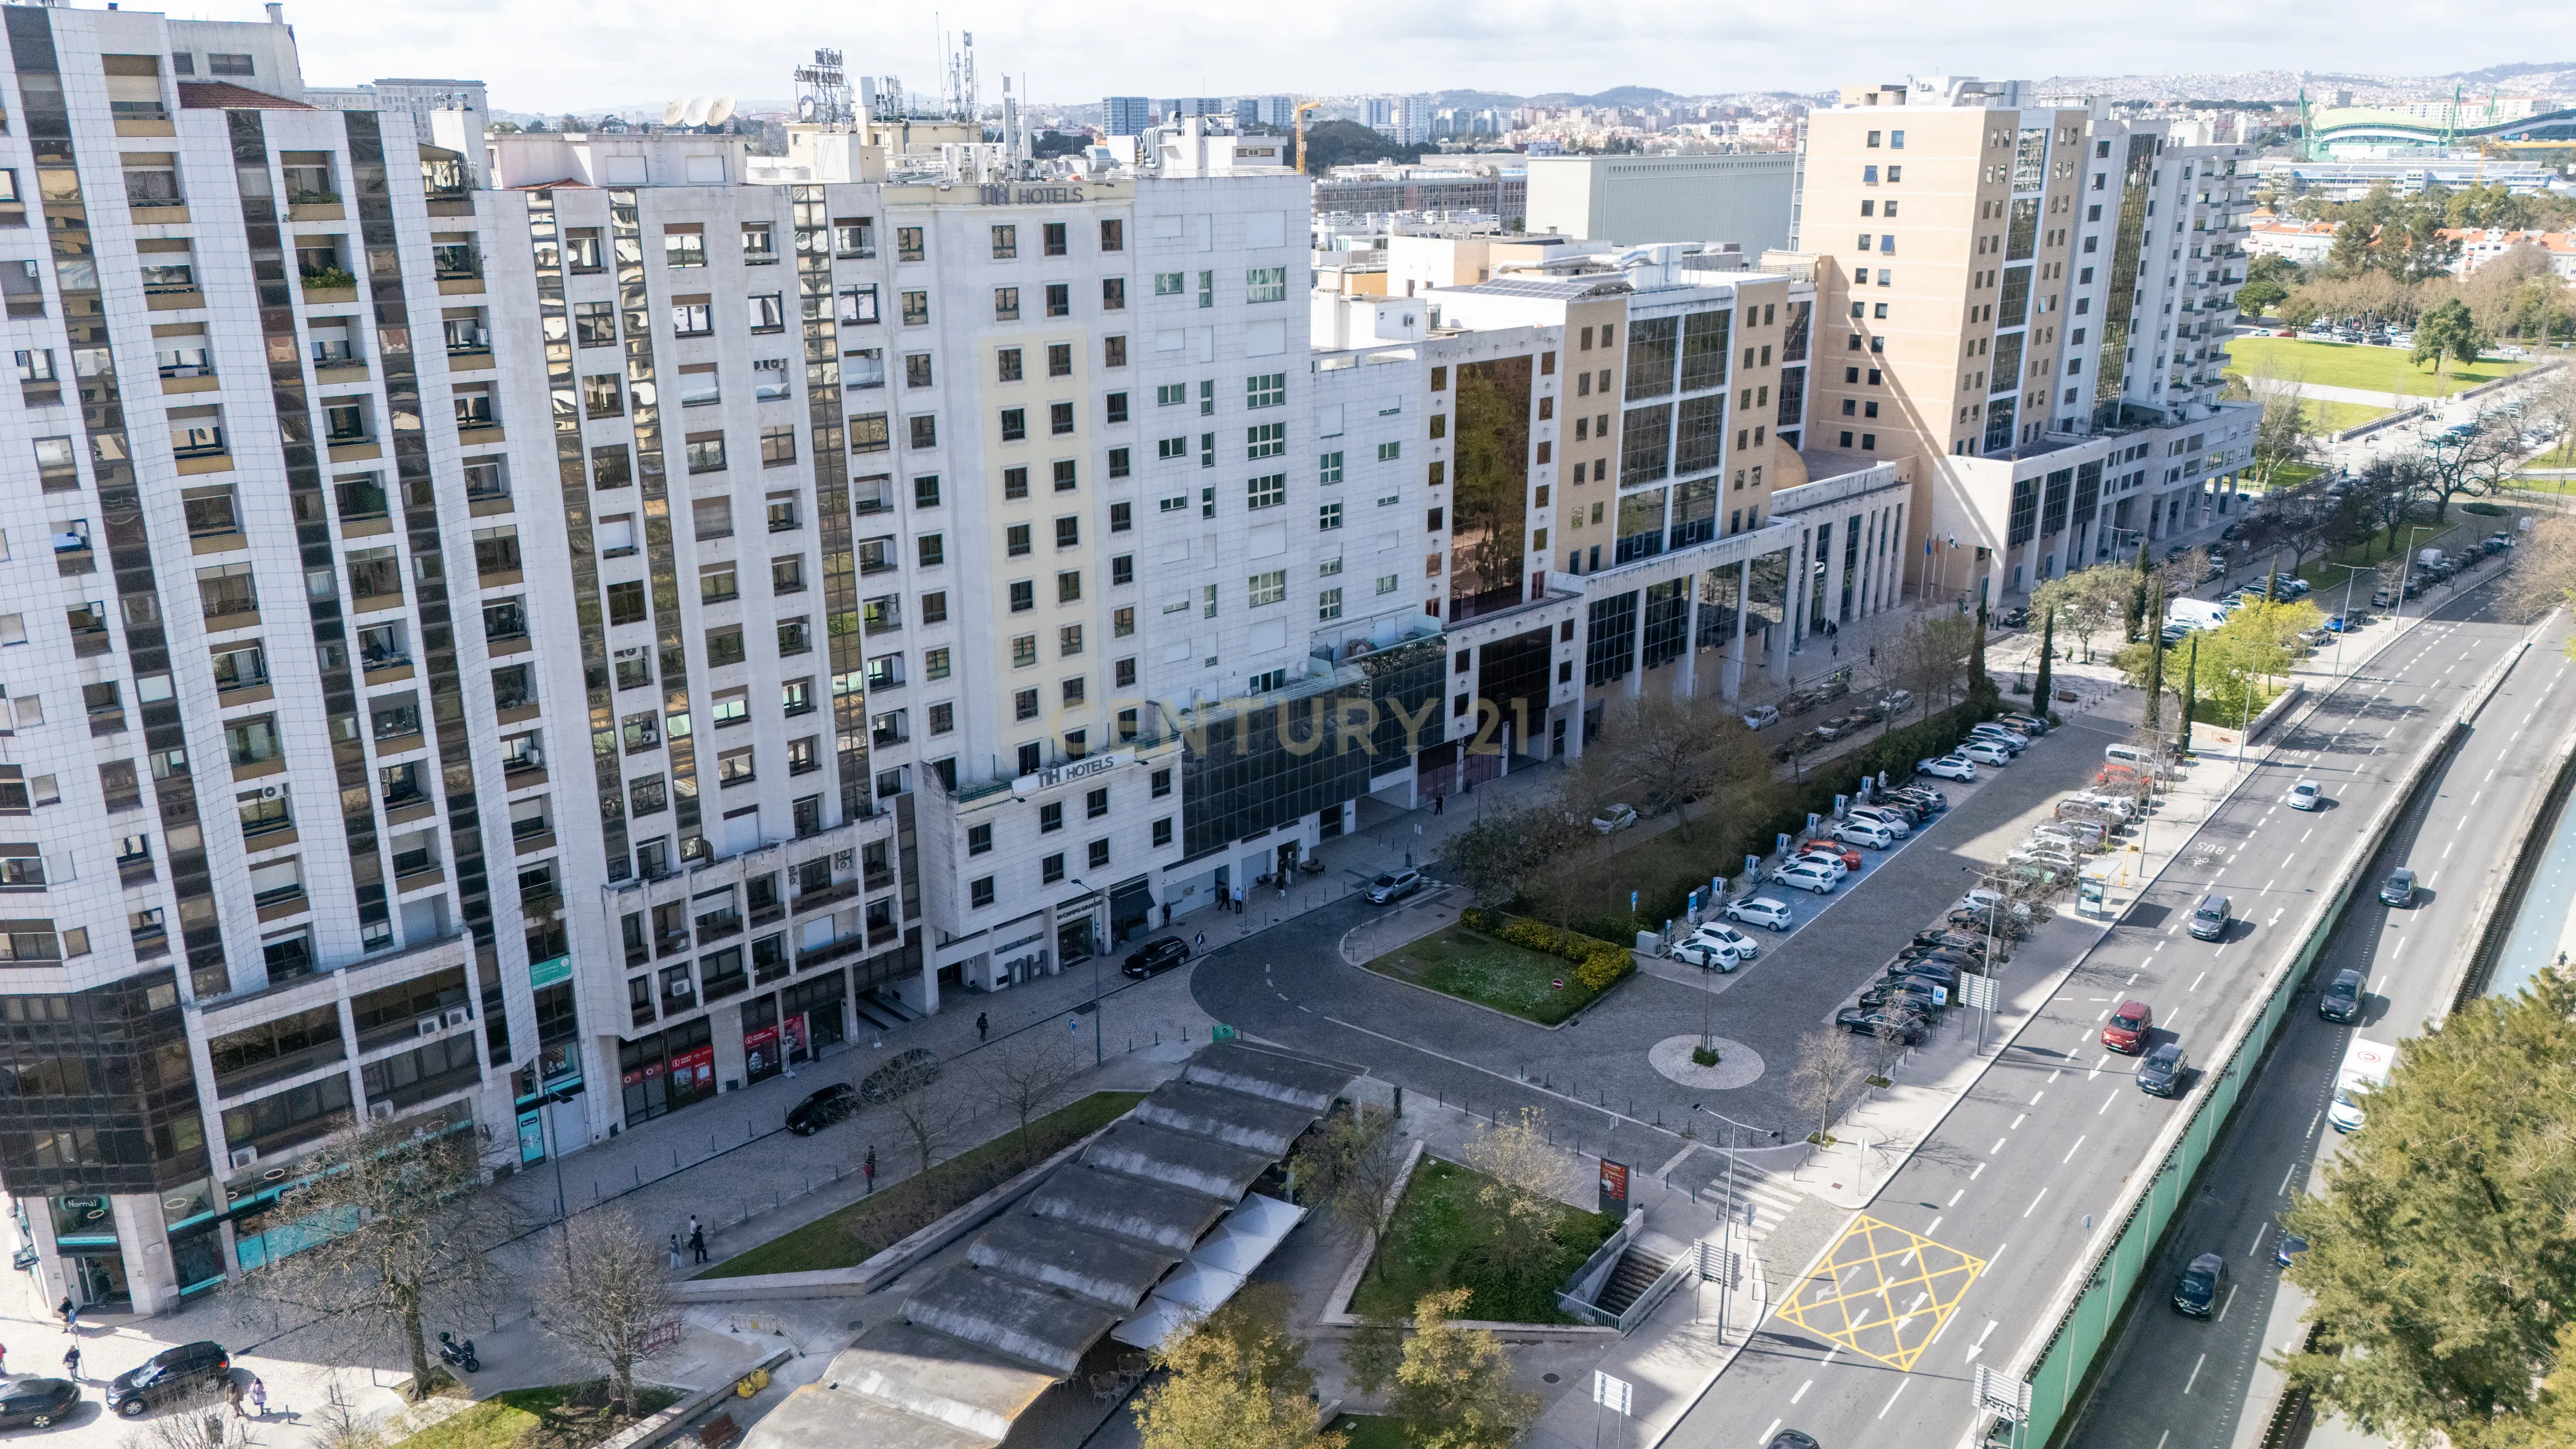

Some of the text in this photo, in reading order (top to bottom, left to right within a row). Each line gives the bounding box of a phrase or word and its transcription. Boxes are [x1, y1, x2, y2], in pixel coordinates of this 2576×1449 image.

[1018, 187, 1084, 204] HOTELS
[1066, 756, 1114, 780] HOTELS
[2195, 841, 2227, 855] BUS
[1063, 908, 1081, 918] CAMPO
[1082, 900, 1103, 911] GRANDE
[68, 1199, 97, 1208] Normal
[16, 1259, 35, 1269] Normal
